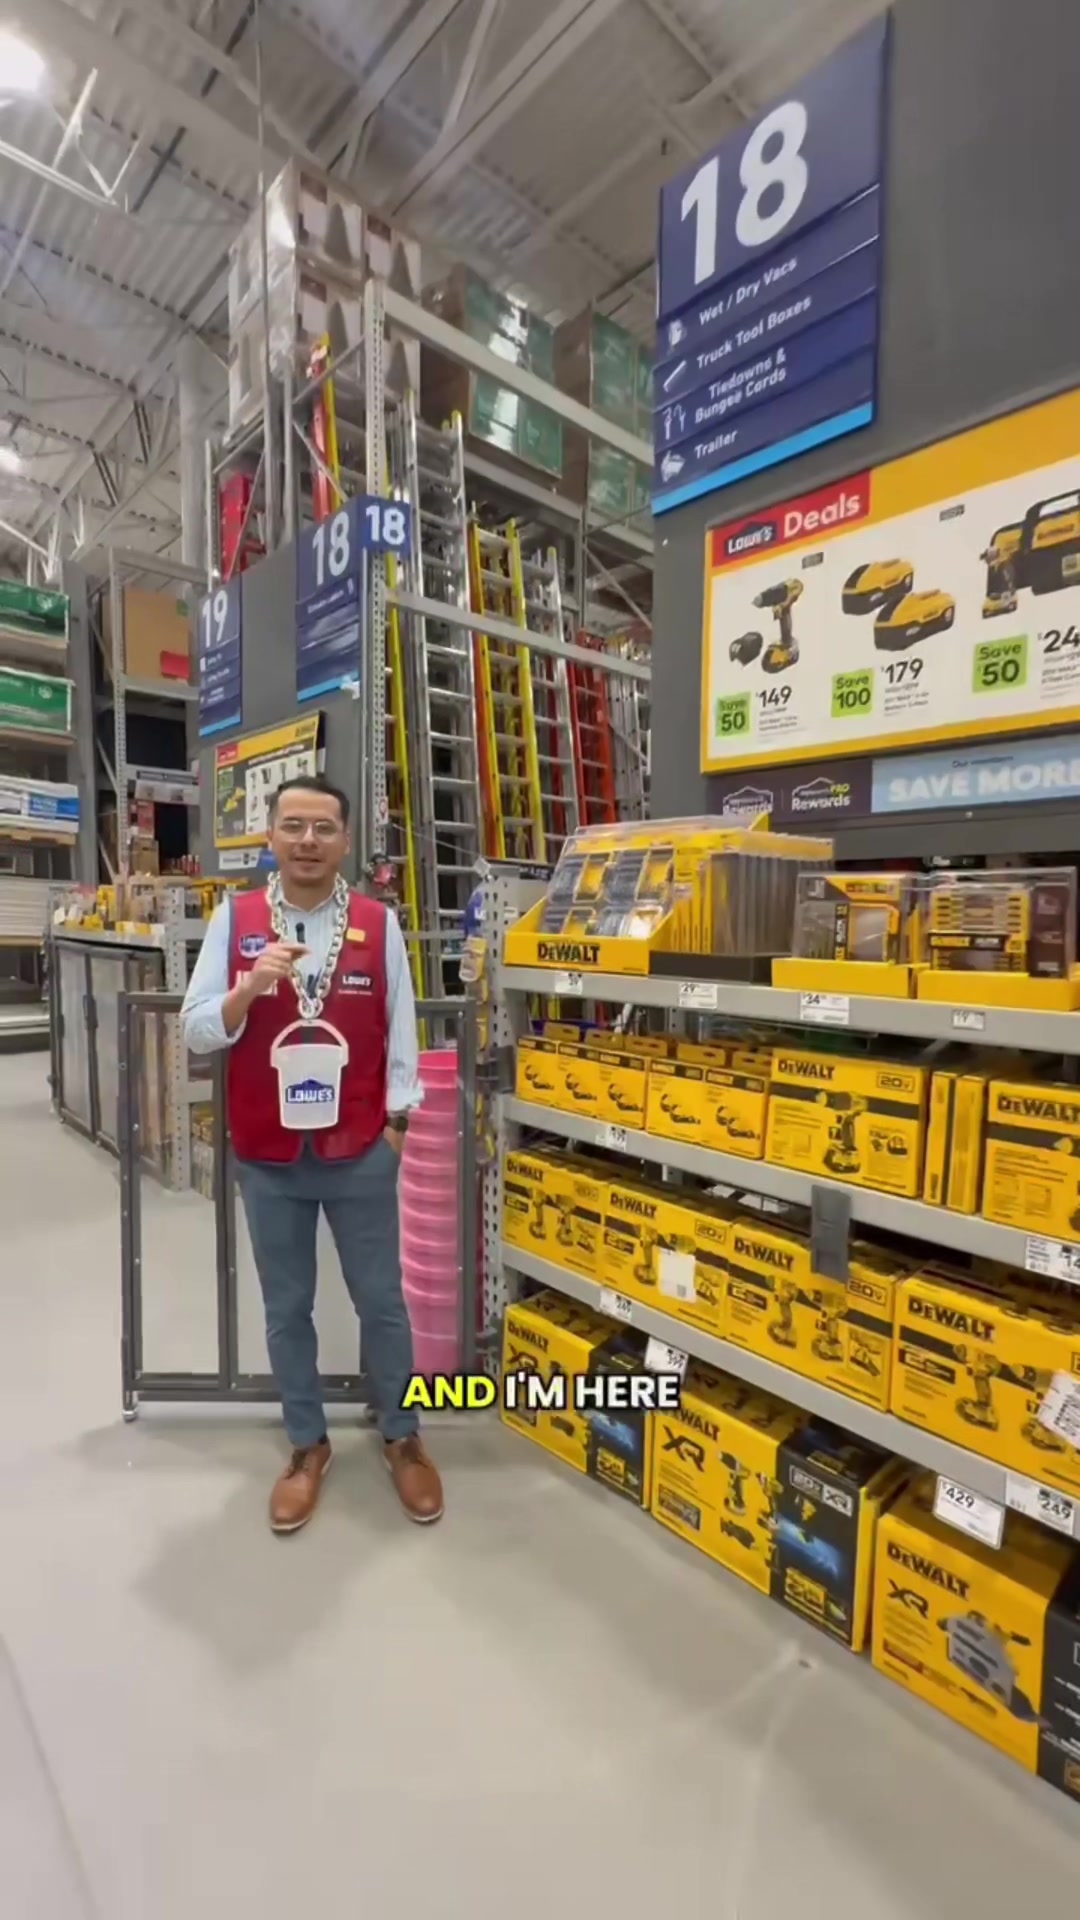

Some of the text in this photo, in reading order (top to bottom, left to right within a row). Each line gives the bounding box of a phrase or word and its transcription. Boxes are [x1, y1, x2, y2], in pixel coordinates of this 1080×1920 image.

[681, 99, 808, 286] 18
[699, 302, 724, 326] Wet
[735, 280, 761, 305] Dry
[763, 257, 798, 287] Vacs
[696, 296, 812, 369] Truck Tool Boxes
[708, 347, 786, 399] Tiedowns &
[695, 368, 787, 423] Bungee Cords
[695, 430, 738, 459] Trailer
[366, 505, 406, 545] 18
[784, 492, 861, 538] Deals
[312, 511, 350, 586] 18
[202, 590, 228, 648] 19
[979, 643, 1021, 660] Save
[836, 675, 869, 690] Save
[791, 794, 851, 811] Rewards
[889, 770, 970, 803] SAVE
[538, 942, 600, 964] DEWALT
[778, 1059, 835, 1081] DEWALT
[287, 1087, 334, 1104] LOWE'S
[610, 1192, 657, 1220] DEWALT
[734, 1237, 796, 1272] DEWALT
[908, 1297, 996, 1342] DEWALT
[887, 1543, 970, 1601] DEWALT
